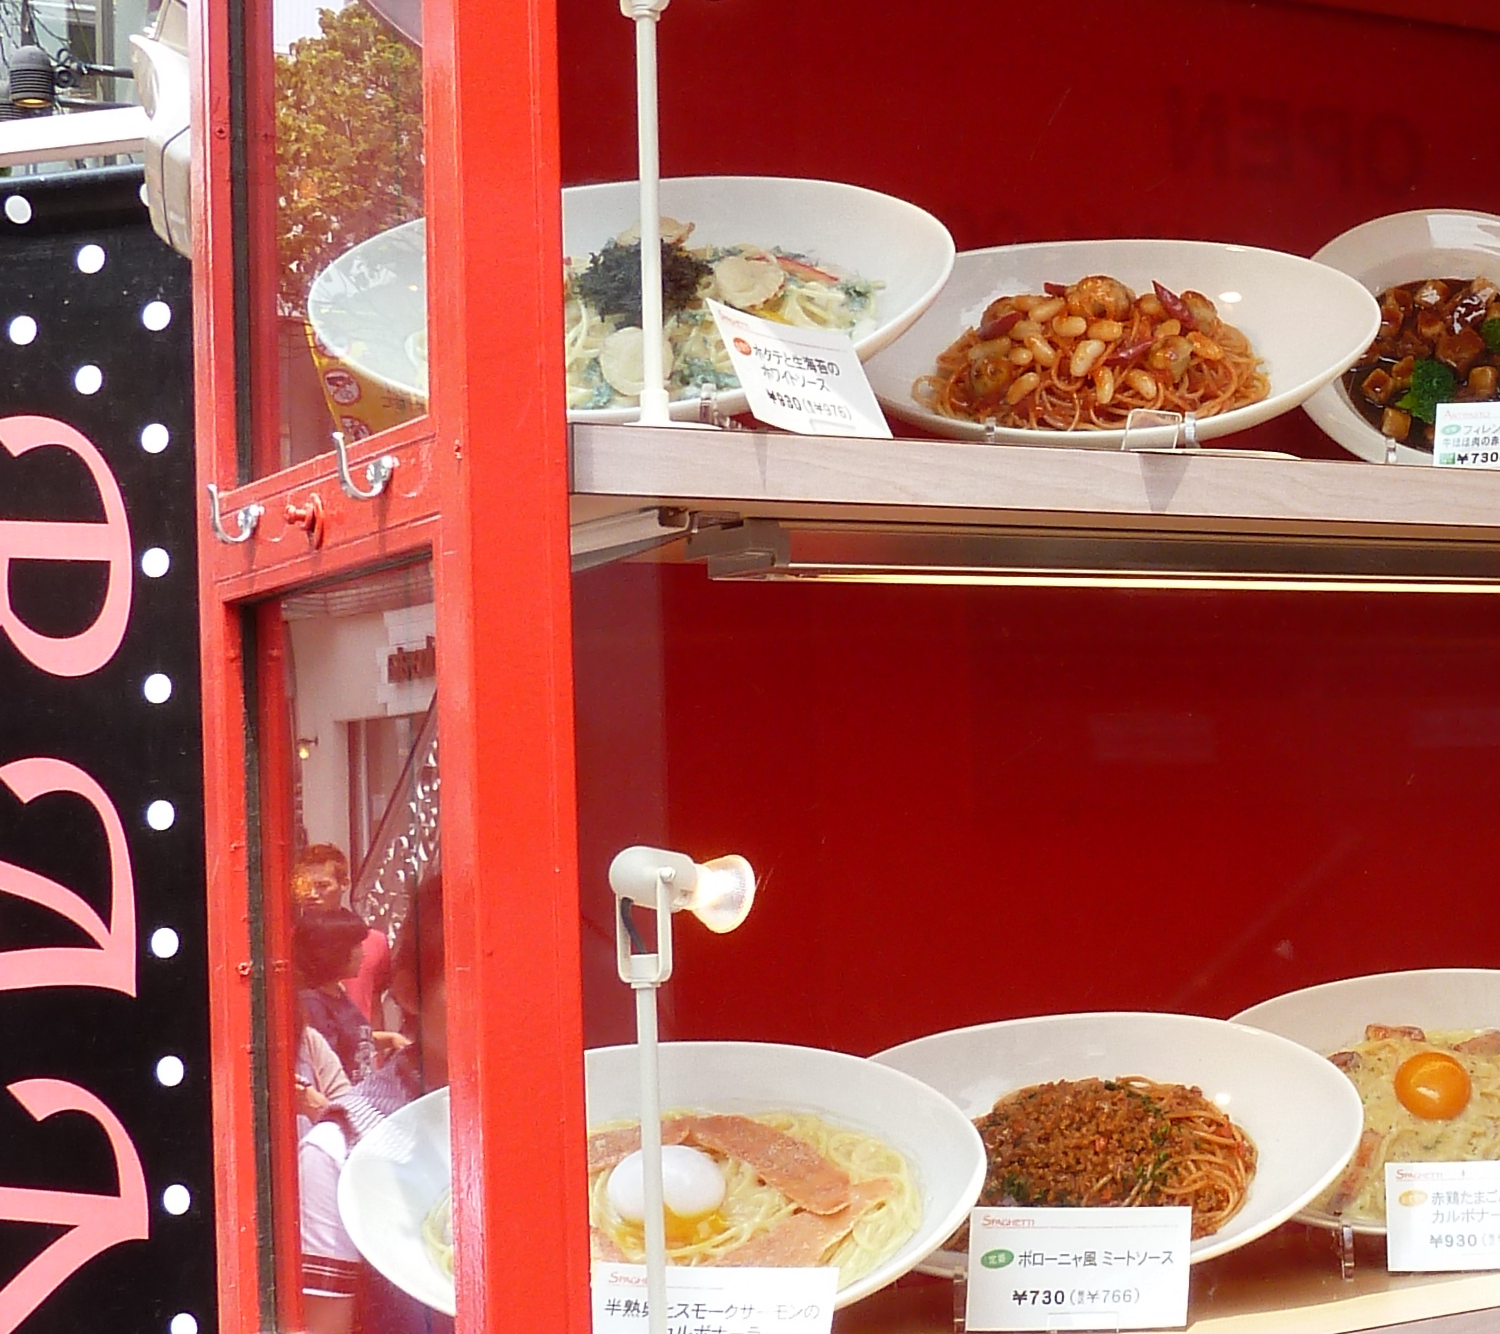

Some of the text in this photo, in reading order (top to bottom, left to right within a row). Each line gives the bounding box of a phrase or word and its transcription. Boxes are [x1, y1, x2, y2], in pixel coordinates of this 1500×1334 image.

[1457, 451, 1499, 465] ¥730
[1429, 1234, 1478, 1249] ¥930
[1018, 1251, 1098, 1268] ボローニャ風
[1102, 1250, 1175, 1267] ミートソース
[1012, 1289, 1065, 1306] ¥730
